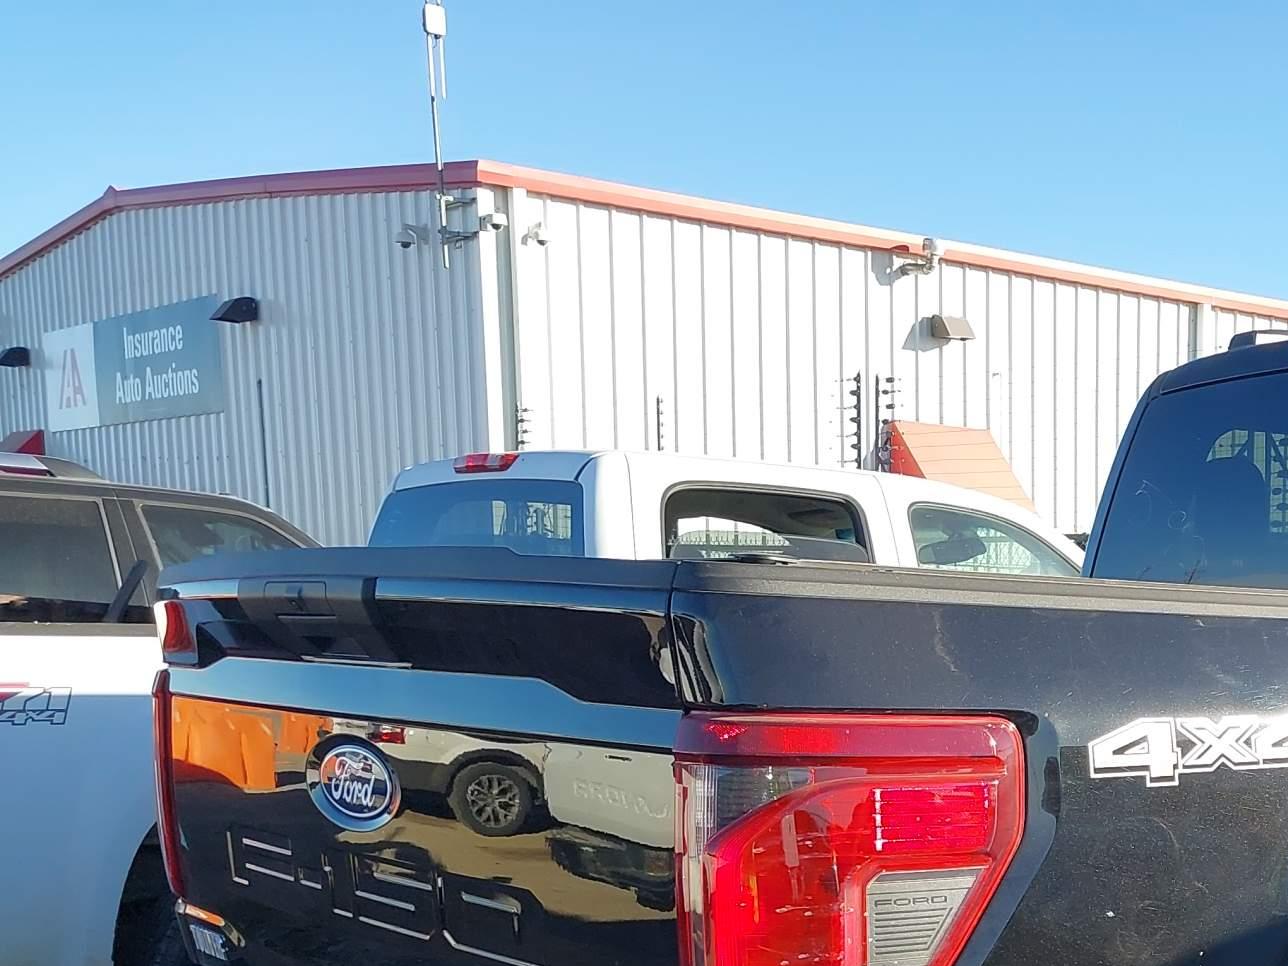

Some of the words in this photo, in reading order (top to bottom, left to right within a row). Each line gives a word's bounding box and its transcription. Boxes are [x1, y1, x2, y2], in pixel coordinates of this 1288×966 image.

[123, 325, 184, 360] Insurance
[115, 372, 142, 404] Auto
[145, 362, 200, 400] Auctions
[332, 756, 376, 807] Ford
[874, 895, 948, 908] FORD
